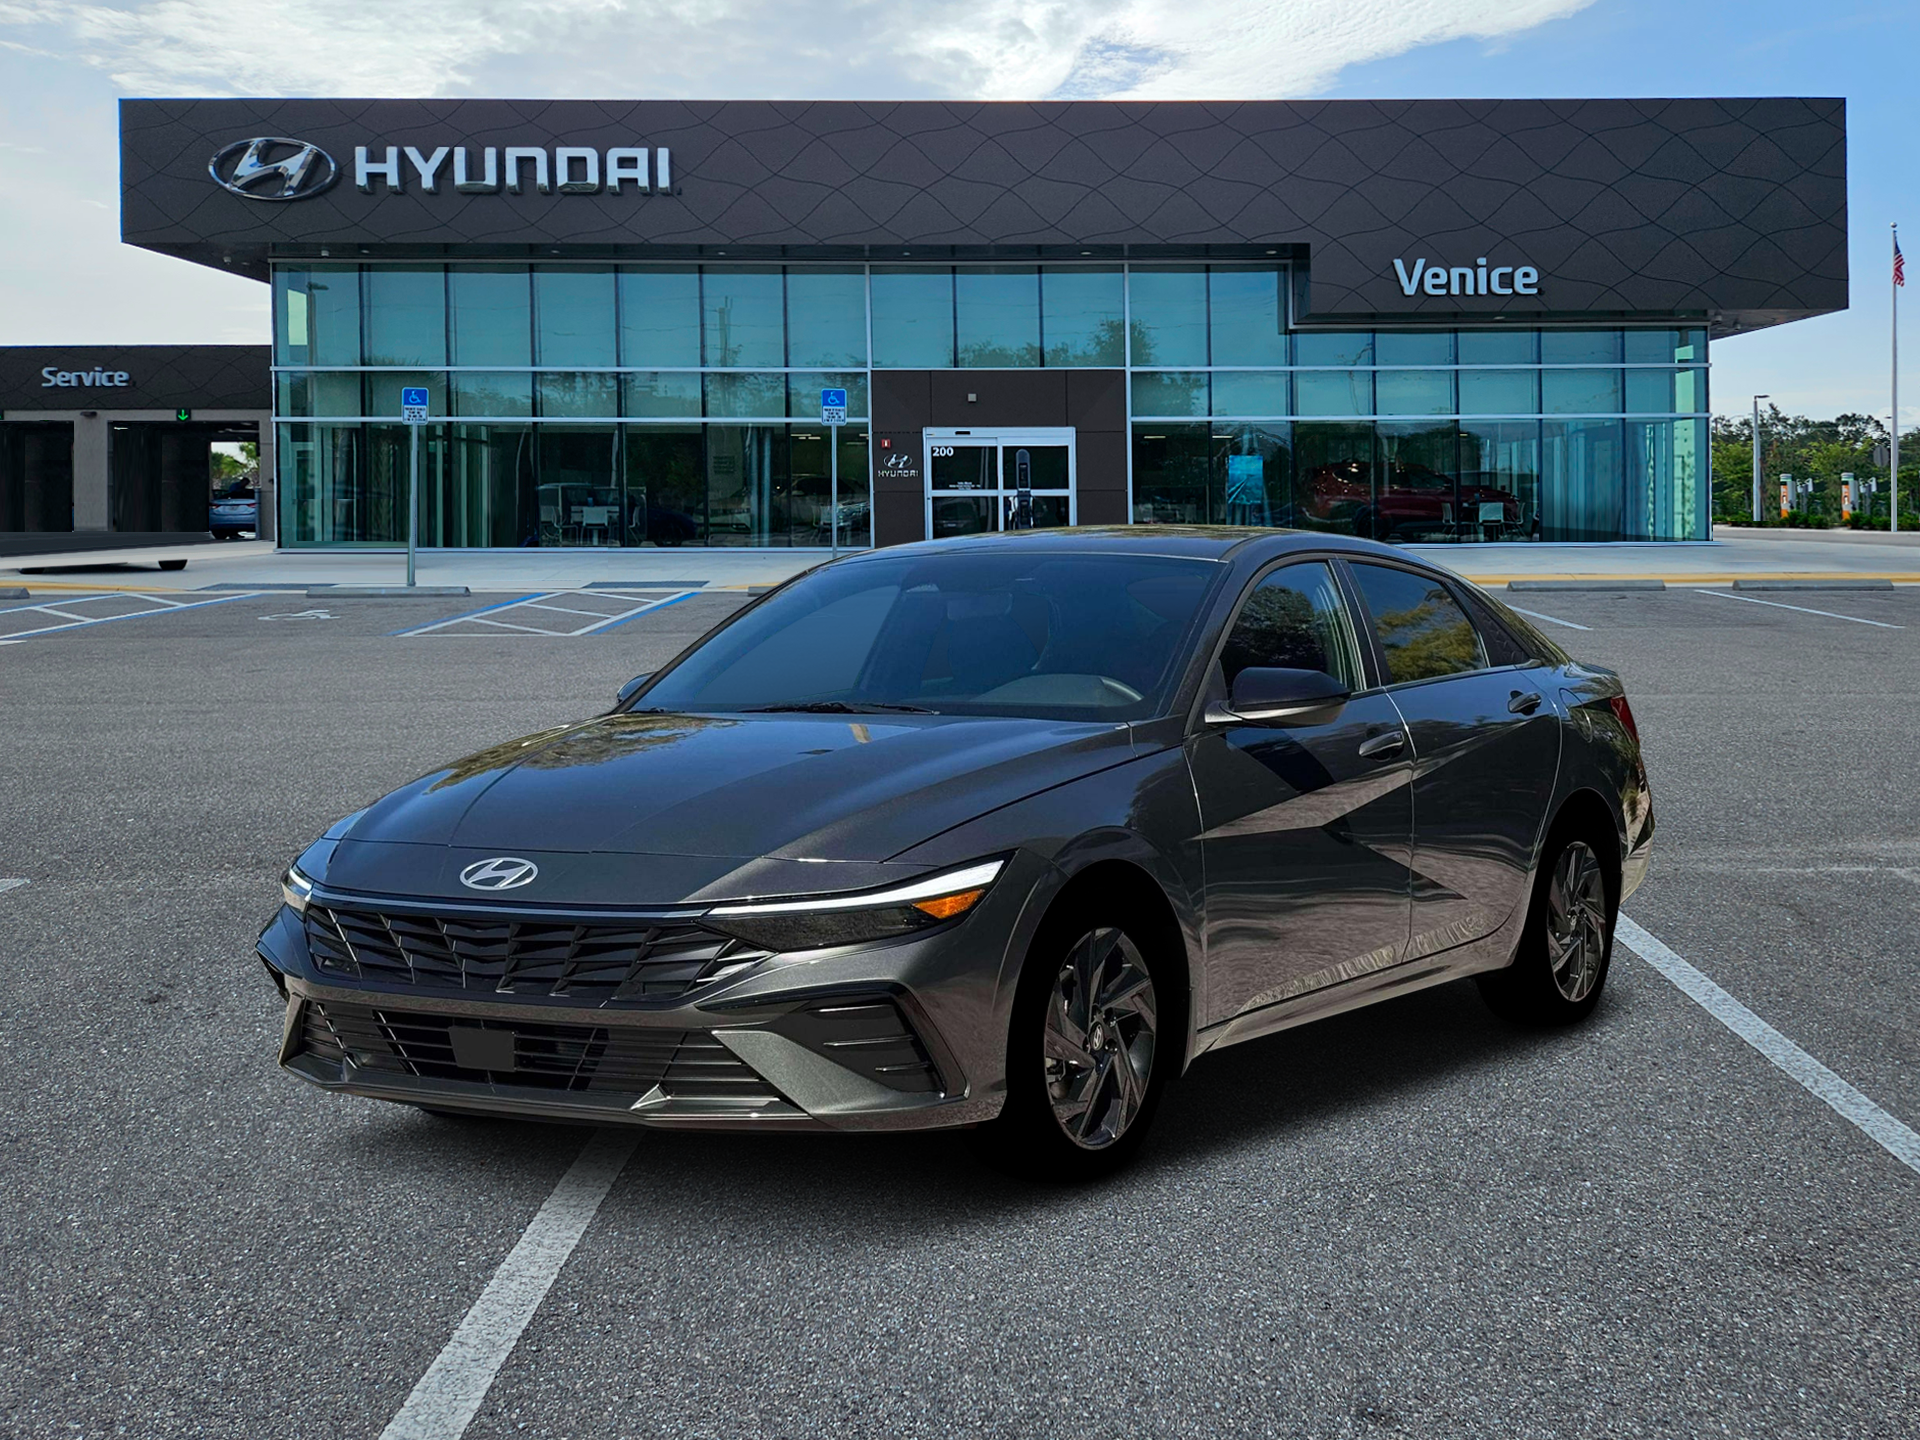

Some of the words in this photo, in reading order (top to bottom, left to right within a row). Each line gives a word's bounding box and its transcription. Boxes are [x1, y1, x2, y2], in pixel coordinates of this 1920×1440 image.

[354, 146, 672, 194] HYUNDAI
[1393, 256, 1539, 296] Venice
[41, 366, 130, 387] Service
[932, 446, 955, 457] 200
[877, 469, 919, 478] HYUNDAI
